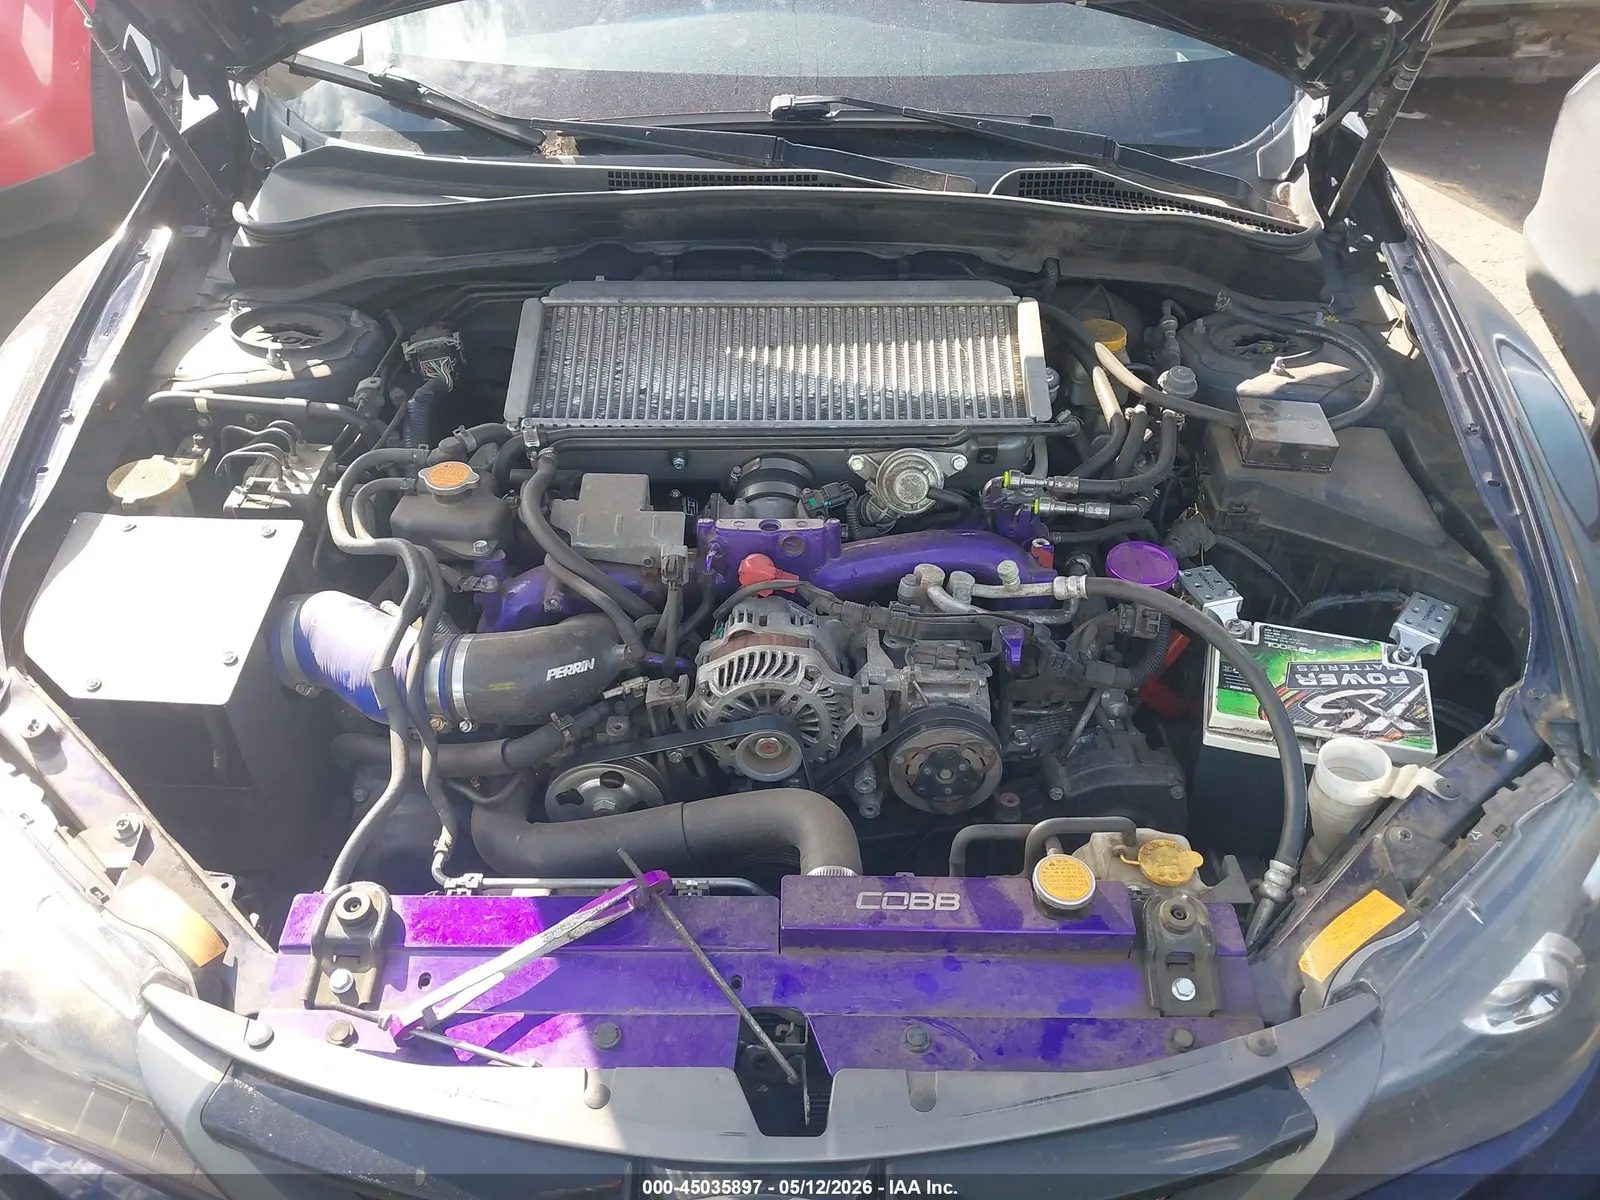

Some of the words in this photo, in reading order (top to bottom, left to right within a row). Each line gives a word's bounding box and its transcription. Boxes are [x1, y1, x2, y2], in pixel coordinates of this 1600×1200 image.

[546, 658, 595, 682] PERRIN
[1295, 671, 1410, 686] POWER
[1304, 683, 1425, 732] XS
[856, 892, 960, 911] COBB
